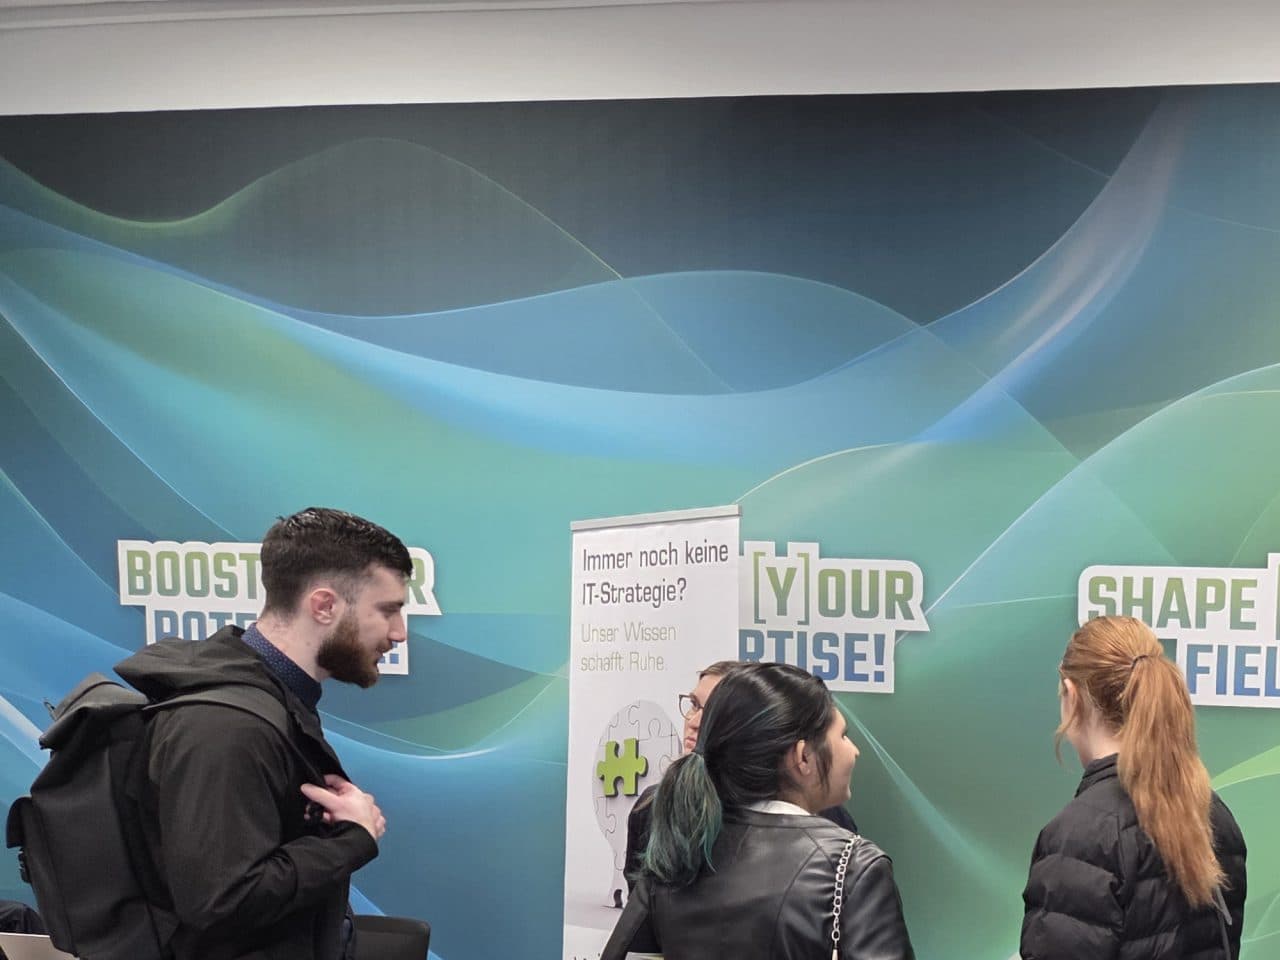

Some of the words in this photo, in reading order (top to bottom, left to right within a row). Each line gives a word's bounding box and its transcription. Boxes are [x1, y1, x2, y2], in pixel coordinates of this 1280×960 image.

[126, 550, 261, 600] BOOST
[583, 548, 633, 571] Immer
[639, 541, 678, 567] noch
[685, 538, 729, 565] keine
[582, 577, 687, 608] IT-Strategie?
[753, 551, 915, 626] [Y]OUR
[1087, 575, 1258, 631] SHAPE
[580, 622, 619, 642] Unser
[624, 620, 677, 642] Wissen
[580, 652, 624, 672] schafft
[739, 629, 886, 683] RTISE!
